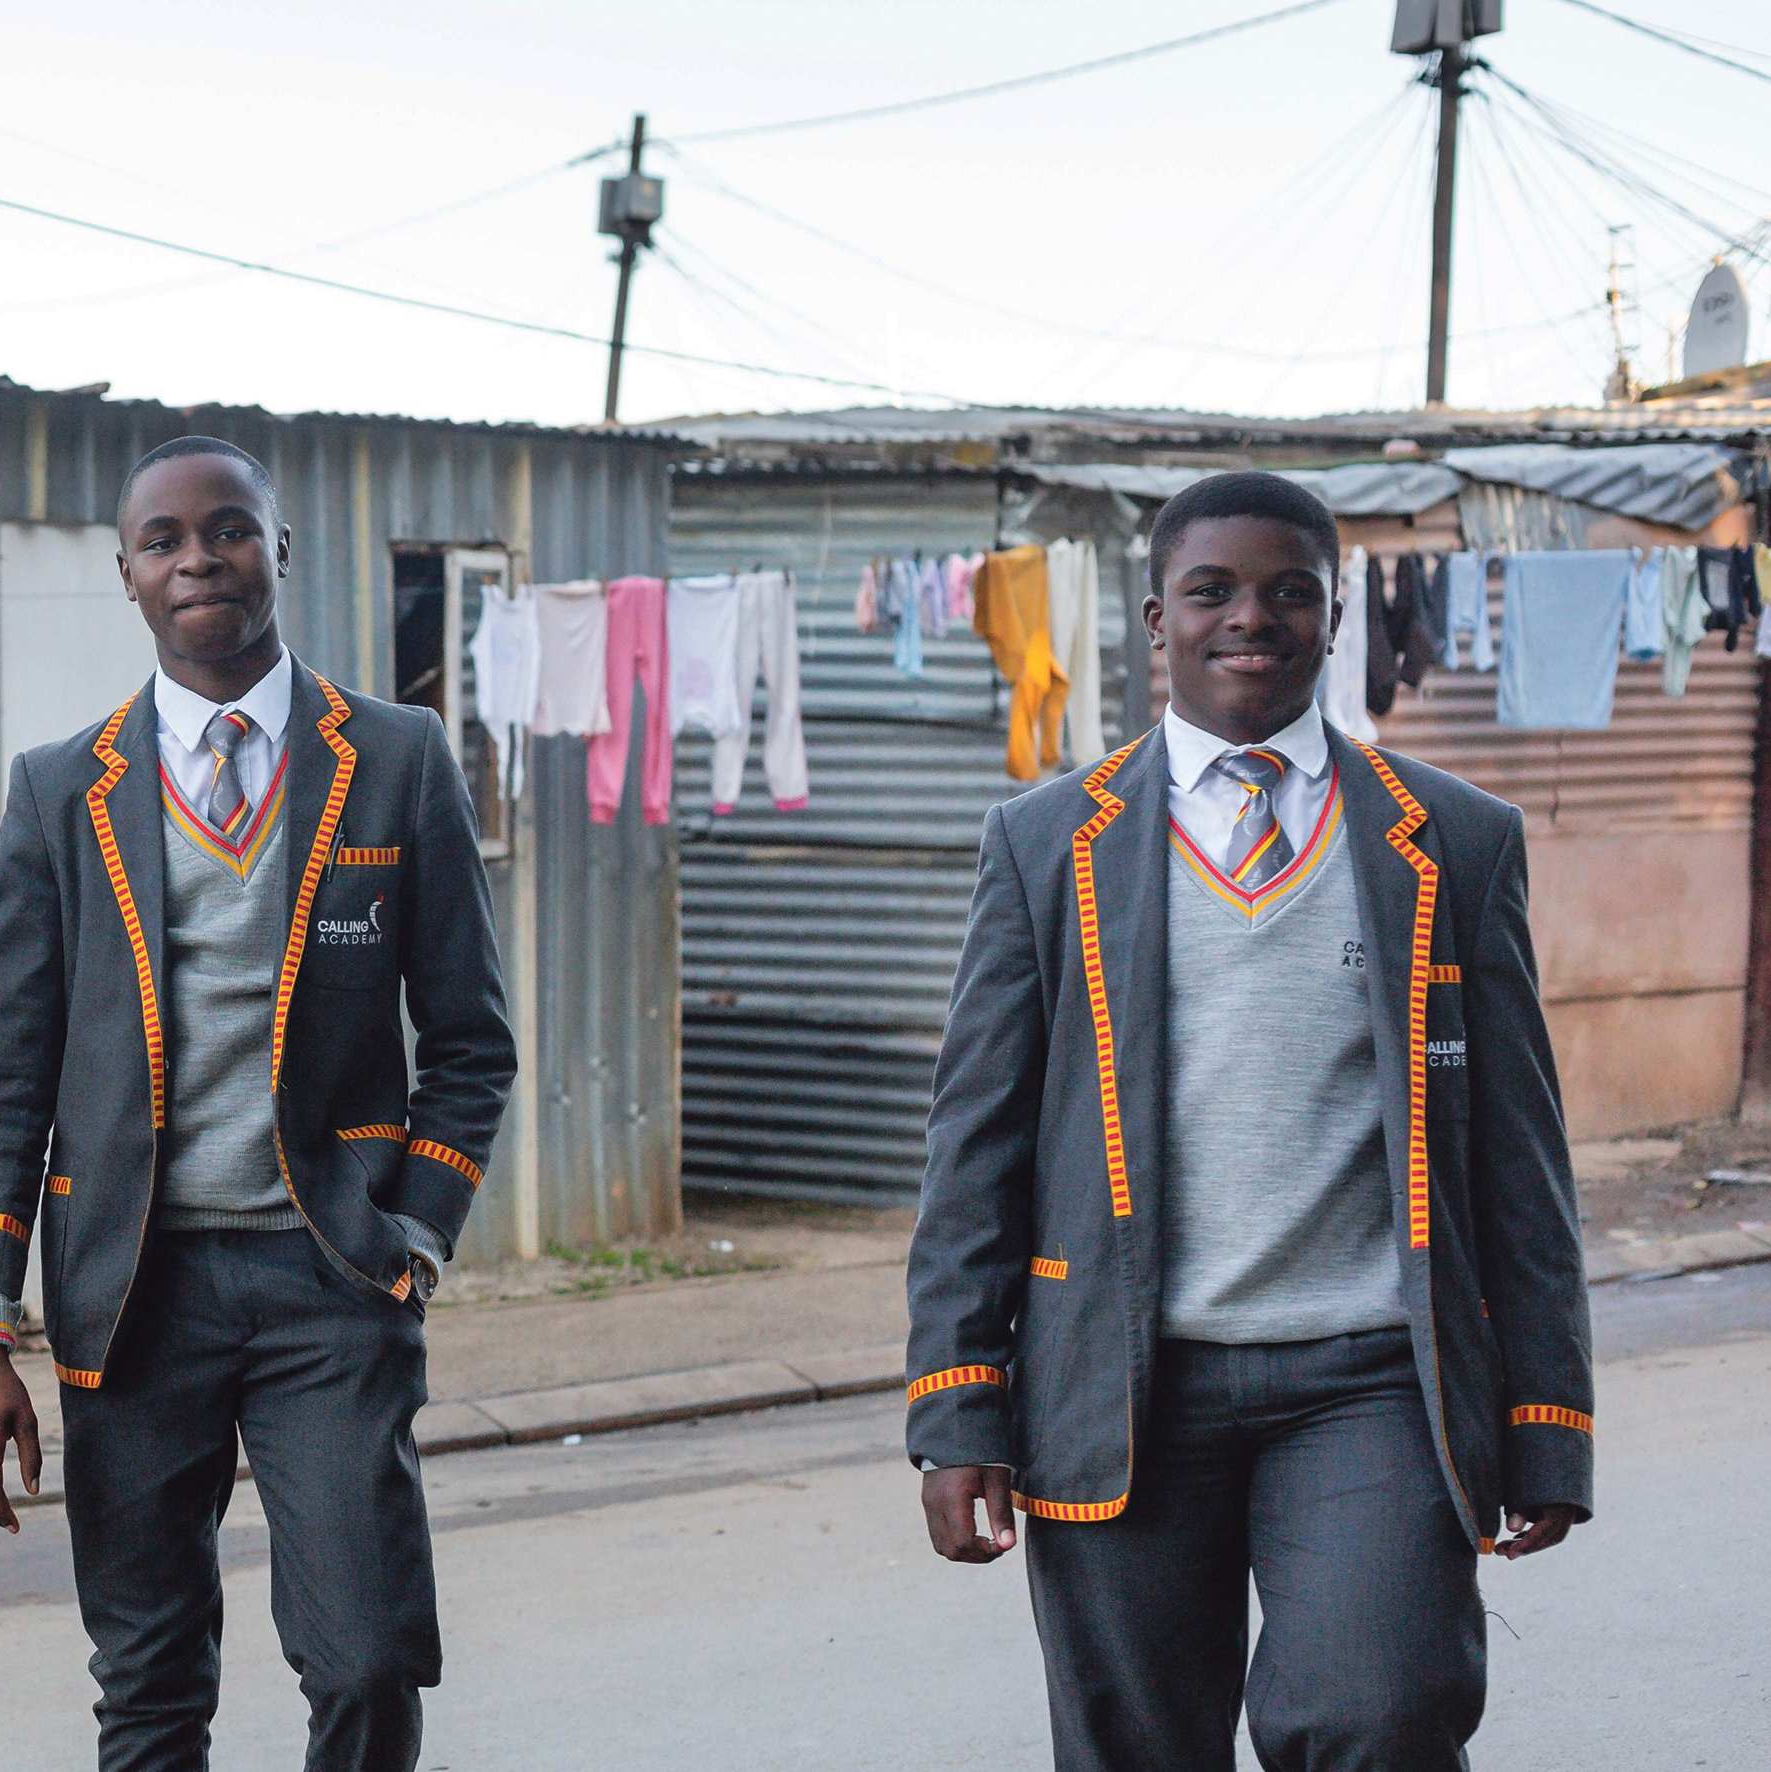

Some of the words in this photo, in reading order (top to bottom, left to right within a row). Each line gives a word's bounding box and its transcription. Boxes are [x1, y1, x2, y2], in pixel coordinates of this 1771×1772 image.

[317, 920, 369, 933] CALLING
[318, 933, 382, 945] ACADEMY
[1423, 1040, 1466, 1055] ALLING
